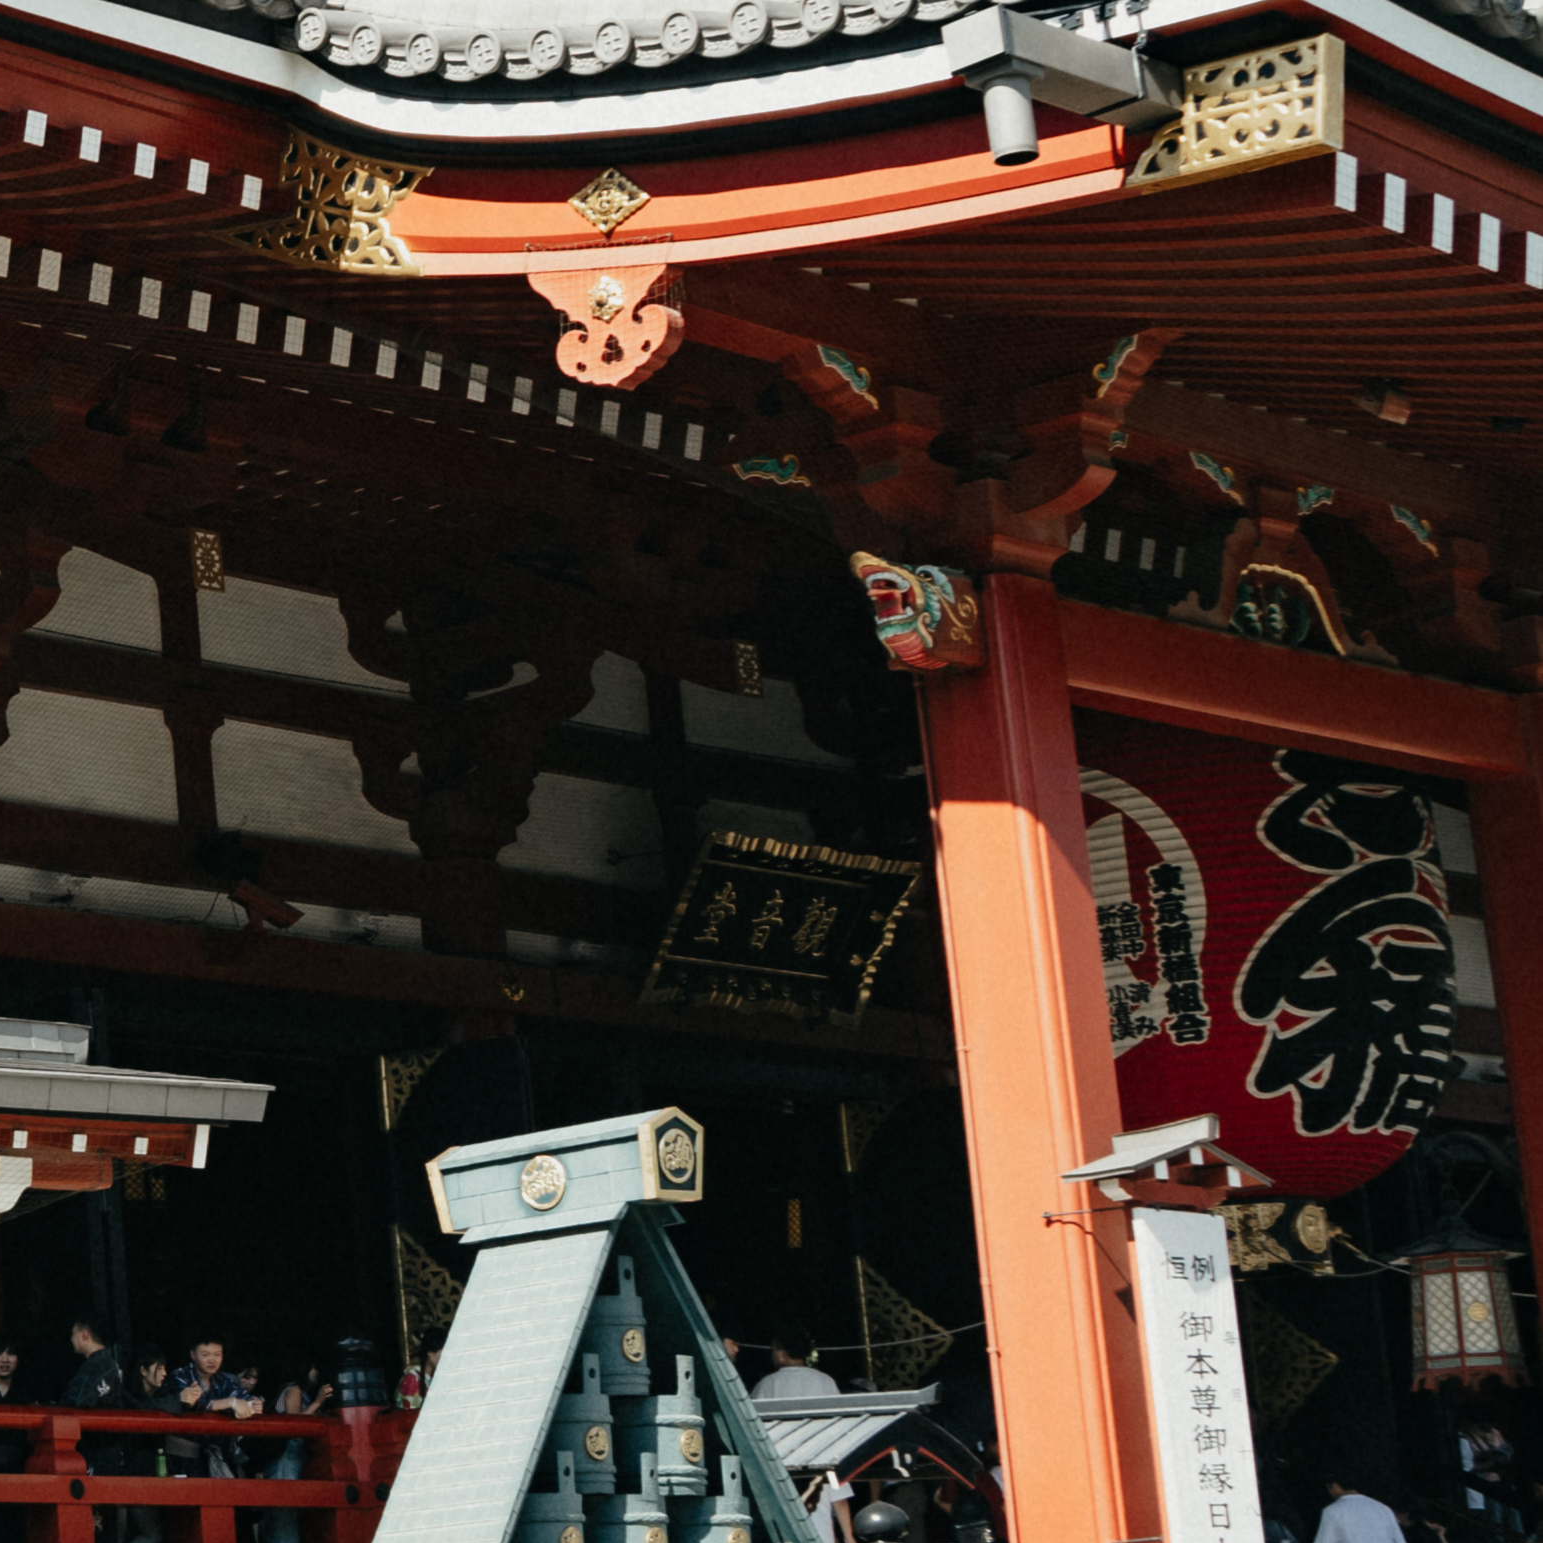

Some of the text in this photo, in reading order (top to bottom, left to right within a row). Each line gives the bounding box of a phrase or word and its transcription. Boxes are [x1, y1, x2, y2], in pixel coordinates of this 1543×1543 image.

[1145, 860, 1211, 1046] 東京新橋組合
[1161, 1251, 1218, 1283] 恒例
